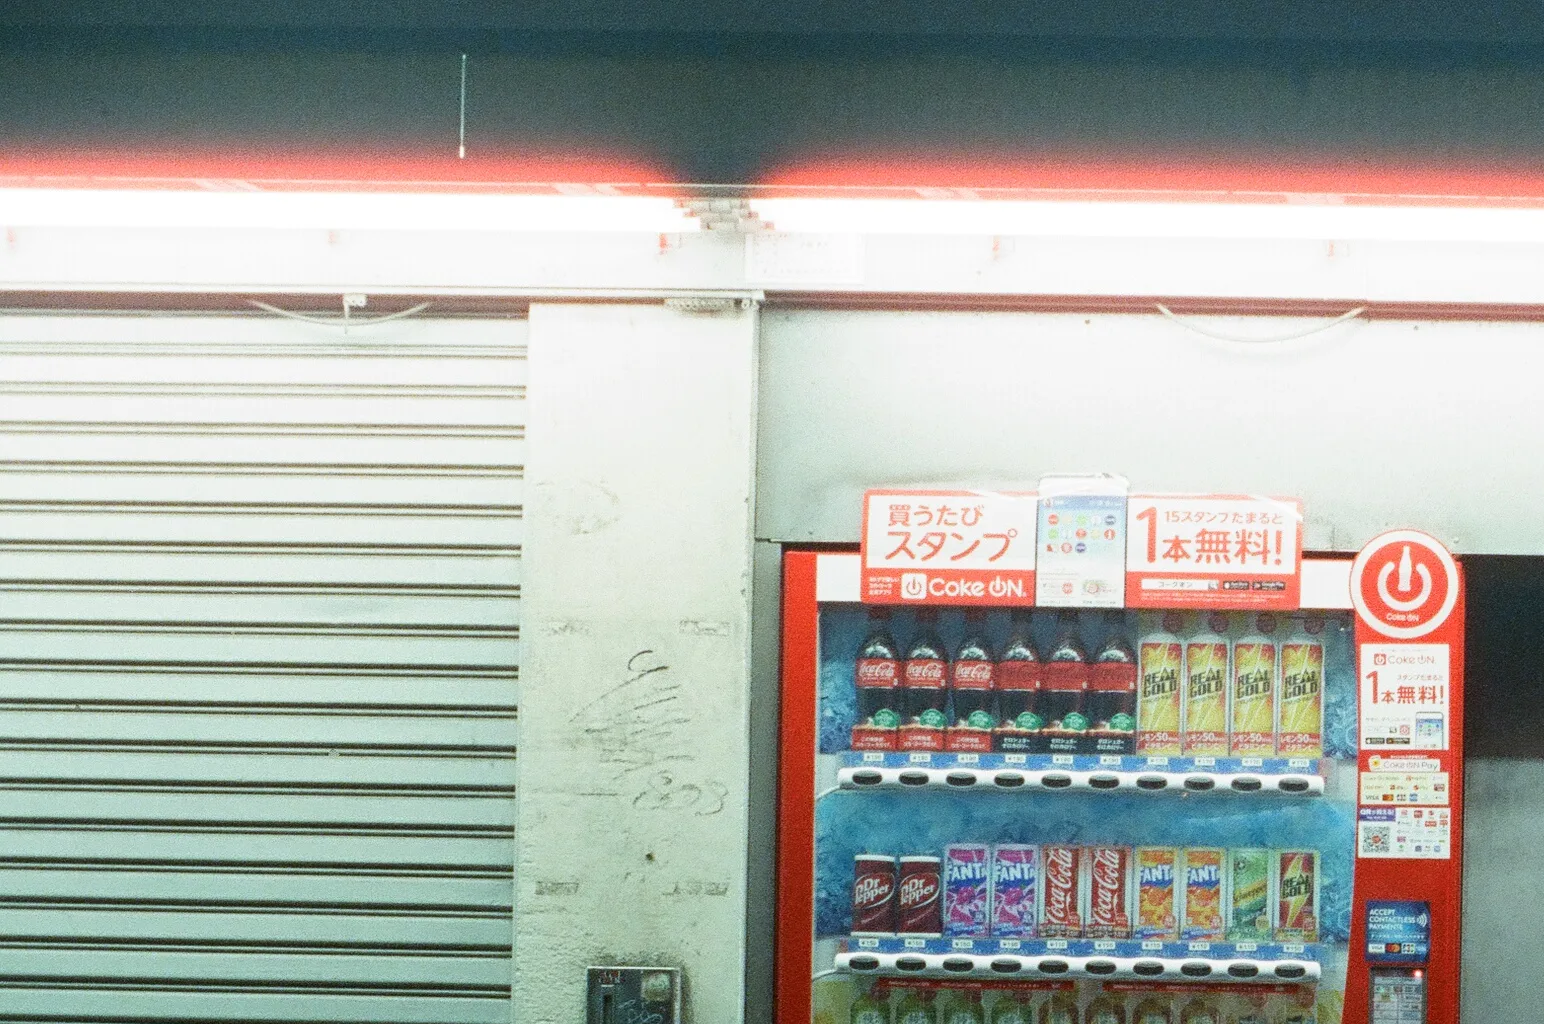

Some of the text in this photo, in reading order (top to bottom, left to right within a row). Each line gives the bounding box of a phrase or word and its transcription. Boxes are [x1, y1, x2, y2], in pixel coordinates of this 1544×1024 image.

[888, 504, 984, 527] 買うたび
[1164, 510, 1284, 524] 15スタンプたまると
[885, 528, 1018, 562] スタンプ
[928, 577, 985, 597] Coke
[859, 661, 895, 678] Coca-Cola
[1388, 654, 1415, 666] Coke
[906, 661, 942, 679] Coca-Cola
[955, 663, 991, 680] Coca-Cola
[1144, 667, 1176, 687] REAL
[1190, 668, 1223, 687] REAL
[1238, 668, 1270, 687] REAL
[1284, 669, 1317, 688] REAL
[1143, 678, 1177, 698] GOLD
[1189, 678, 1223, 698] GOLD
[1237, 679, 1271, 698] GOLD
[1284, 680, 1318, 700] GOLD
[864, 878, 880, 891] Dr
[909, 878, 925, 891] Dr
[1047, 847, 1073, 923] Coca-Cola
[1092, 849, 1120, 925] Coca-Cola
[1282, 874, 1309, 890] REAL
